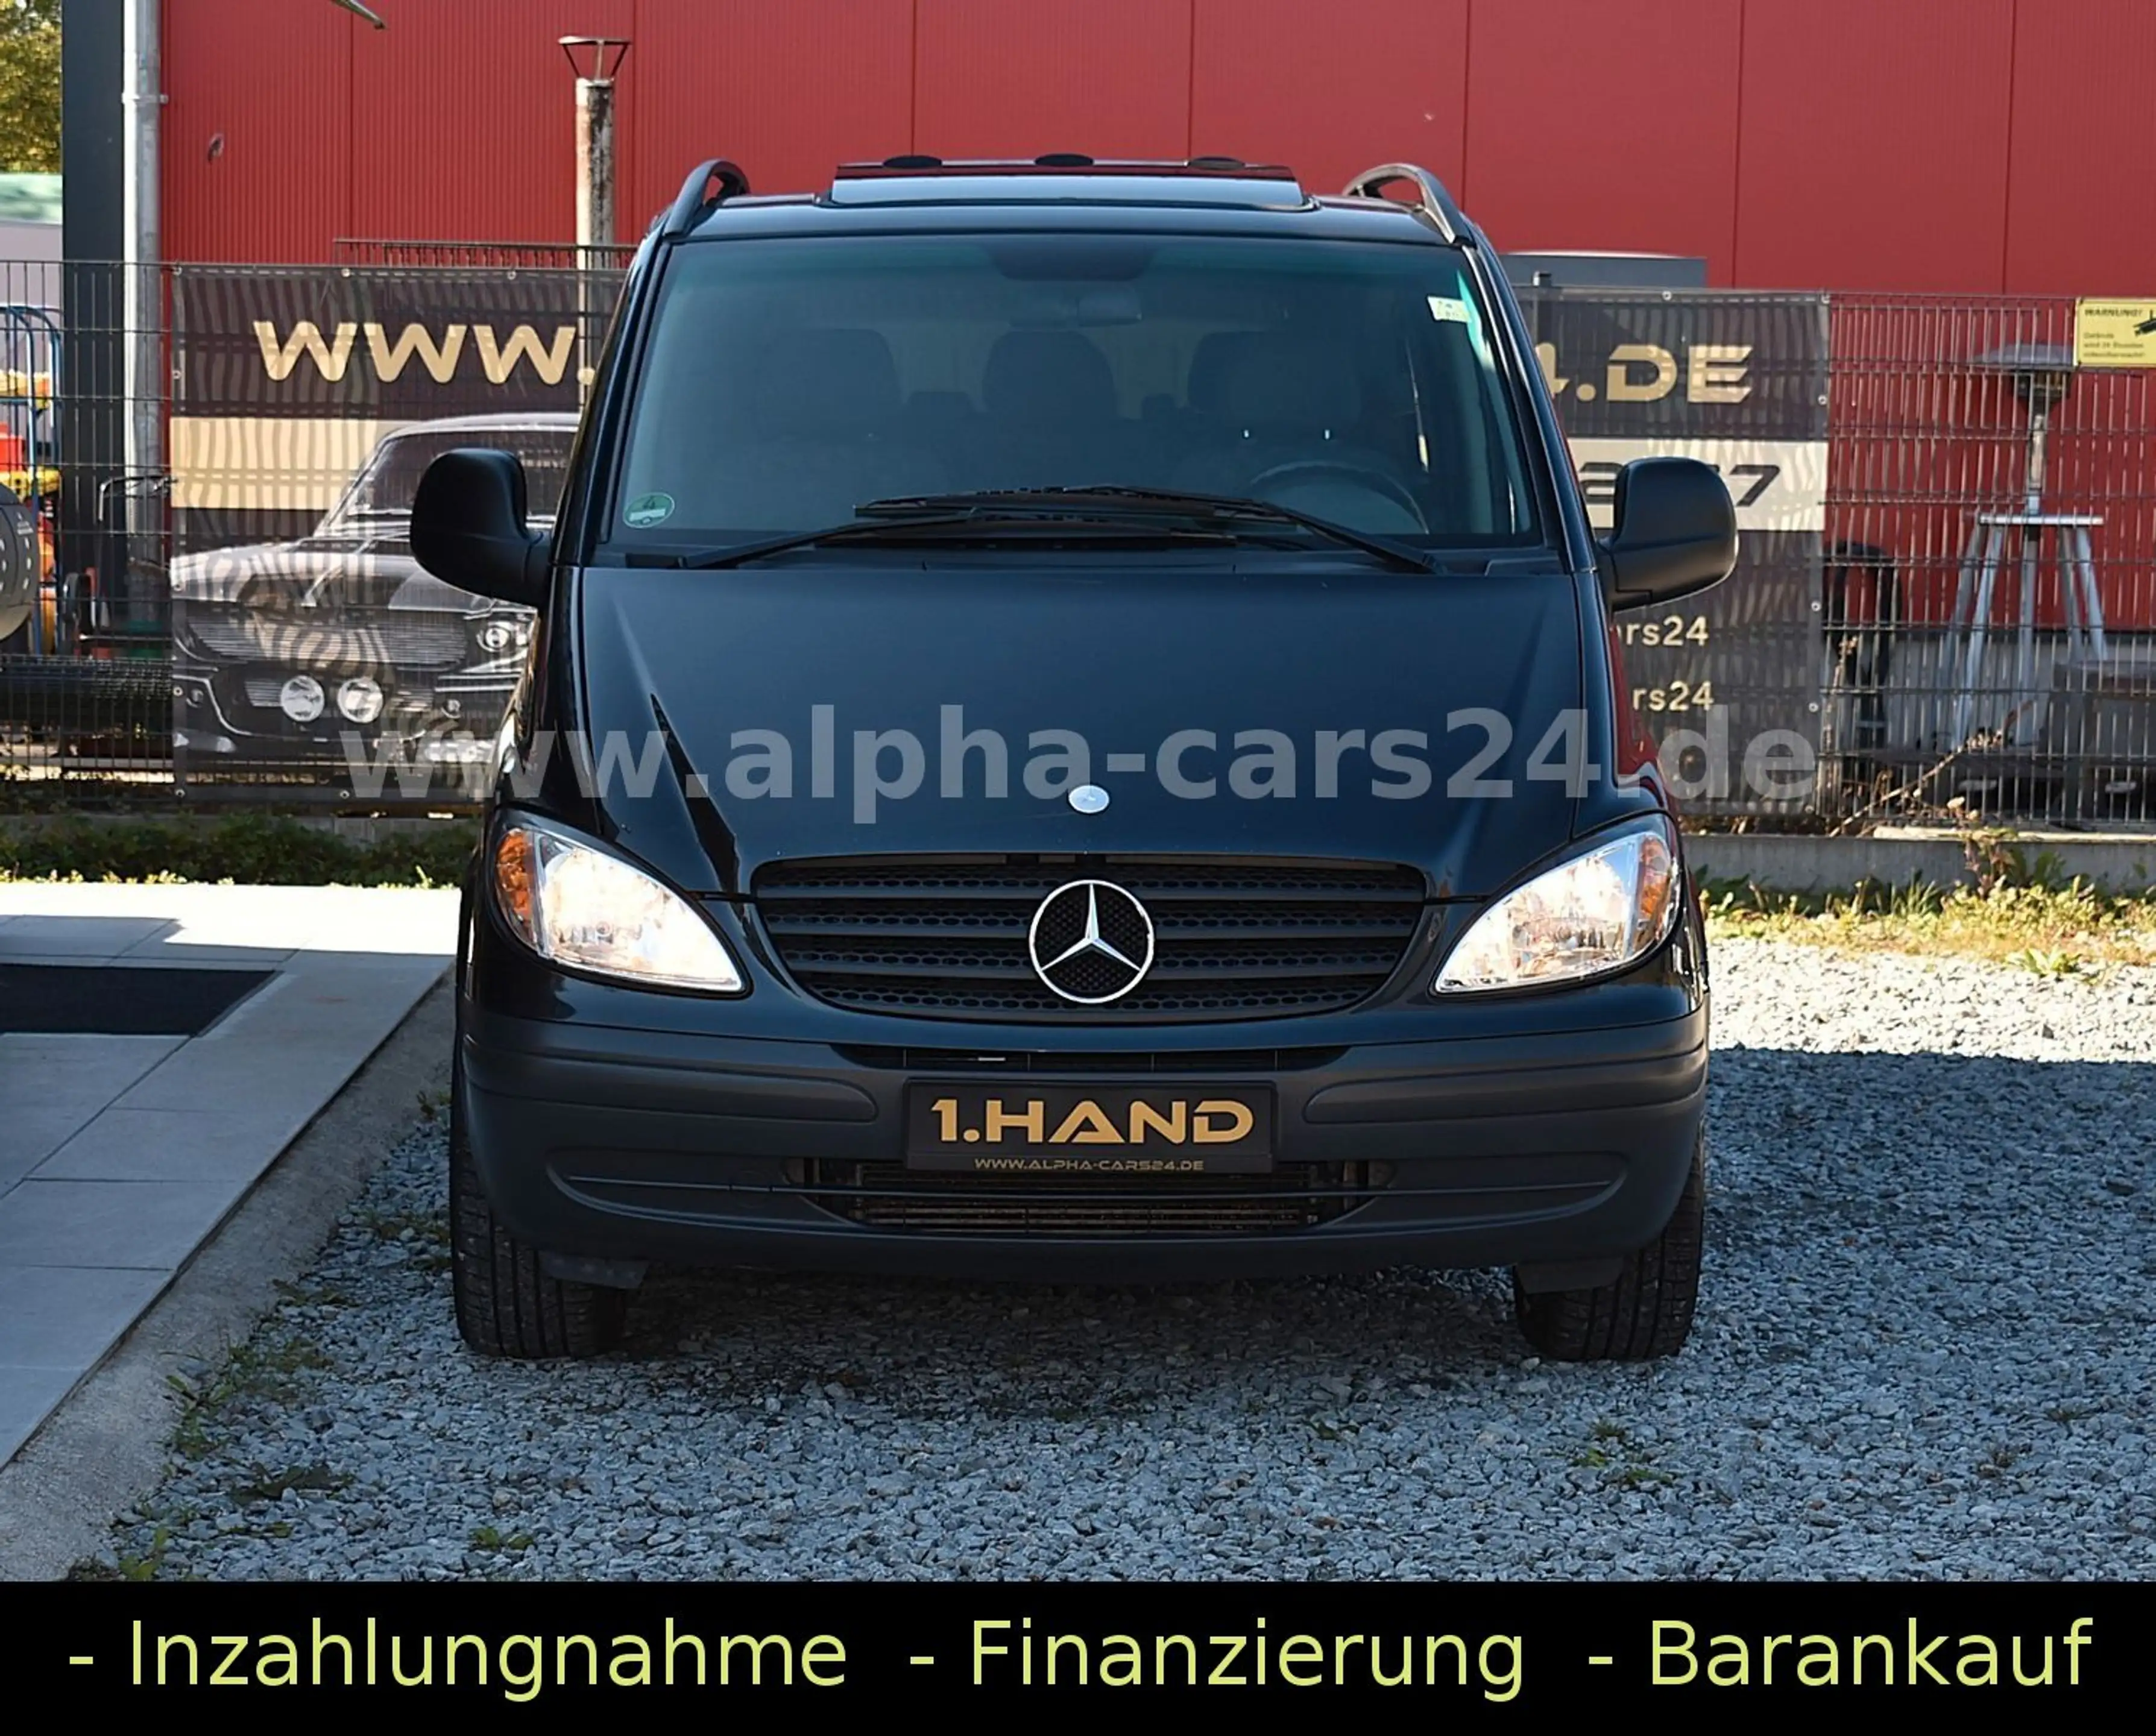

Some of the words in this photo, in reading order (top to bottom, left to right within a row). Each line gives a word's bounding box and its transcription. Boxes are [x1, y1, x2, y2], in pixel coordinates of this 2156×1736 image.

[1616, 614, 1709, 646] rs24
[931, 1099, 1253, 1144] 1.HAND
[974, 1158, 1205, 1171] WWW.ALPHA-CARS24.DE
